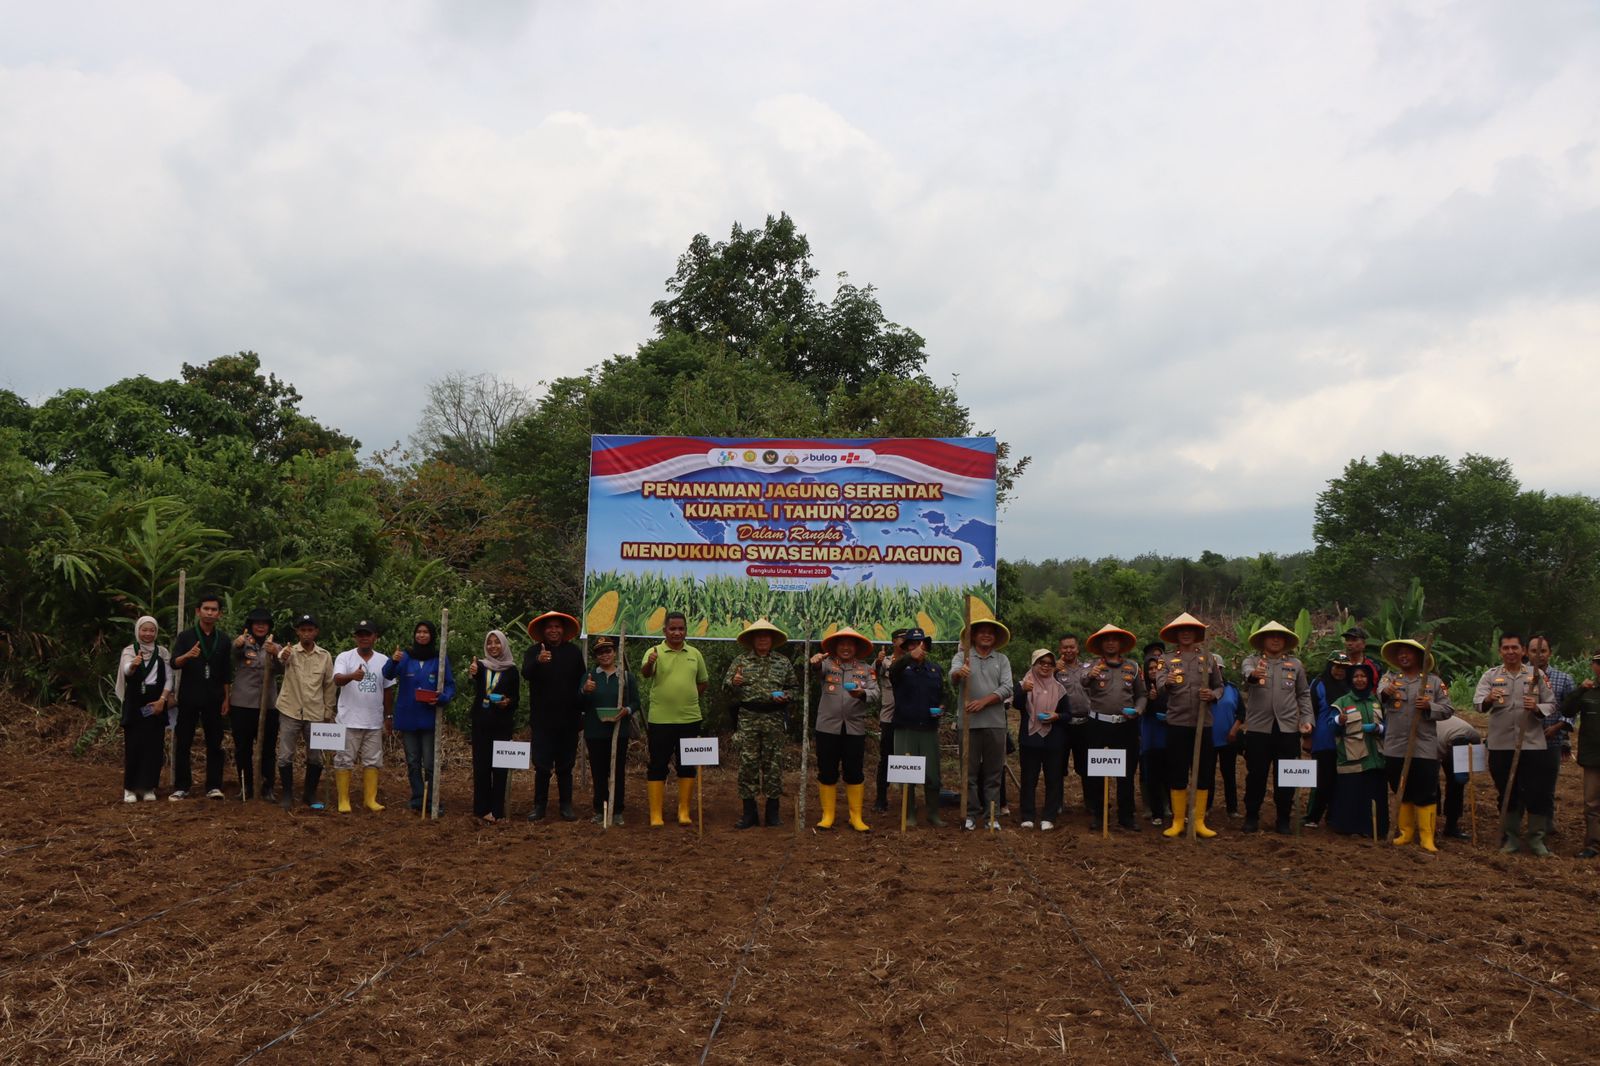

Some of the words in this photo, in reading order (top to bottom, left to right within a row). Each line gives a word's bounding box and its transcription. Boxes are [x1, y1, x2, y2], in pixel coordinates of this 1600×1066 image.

[810, 453, 838, 463] bulog
[642, 482, 761, 499] PENANAMAN
[764, 483, 839, 500] JAGUNG
[843, 483, 942, 500] SERENTAK
[685, 503, 768, 519] KUARTAL
[772, 504, 780, 520] I
[784, 504, 846, 520] TAHUN
[850, 504, 898, 520] 2026
[737, 525, 784, 541] Dalam
[788, 526, 842, 544] Rangka
[621, 543, 742, 560] MENDUKUNG
[745, 545, 881, 561] SWASEMBADA
[884, 546, 960, 562] JAGUNG
[1090, 757, 1121, 765] BUPATI
